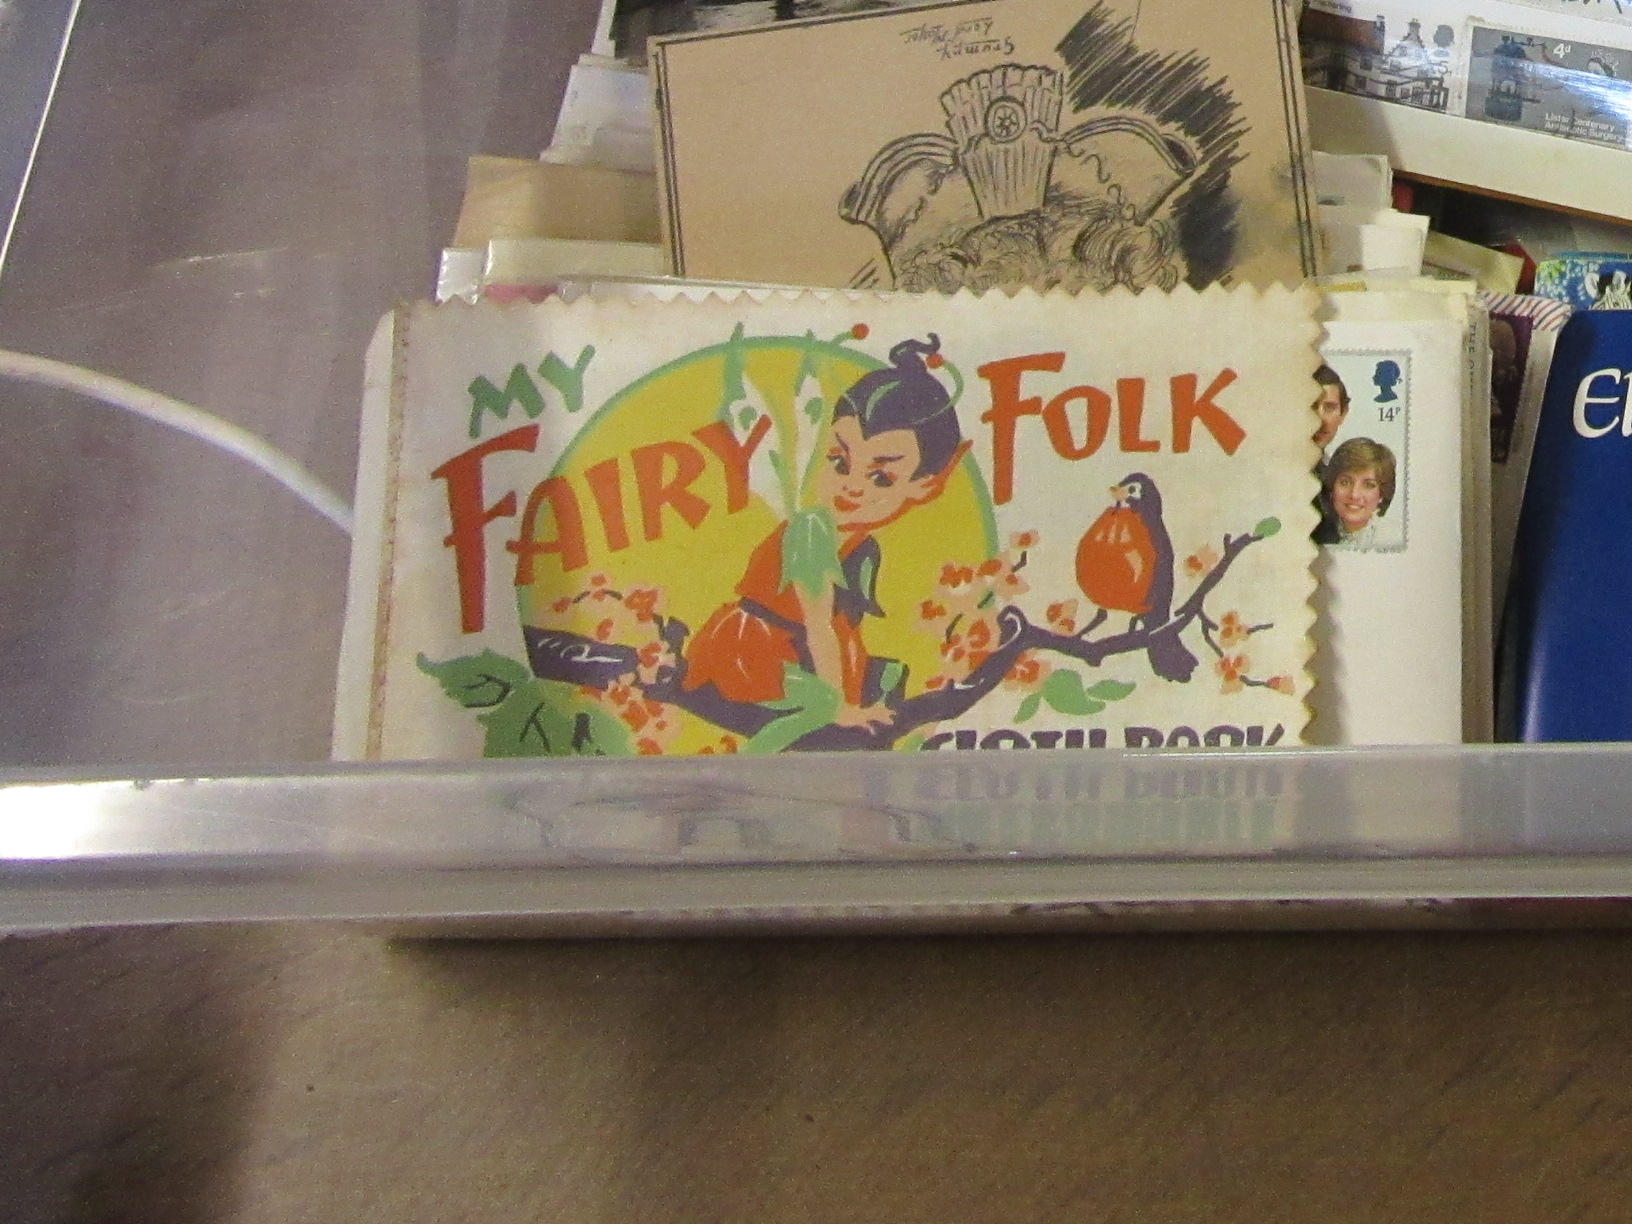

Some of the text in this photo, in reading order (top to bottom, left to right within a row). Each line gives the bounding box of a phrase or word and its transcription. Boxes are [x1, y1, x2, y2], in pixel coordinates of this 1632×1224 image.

[1552, 43, 1572, 60] 4d
[467, 344, 596, 440] MY
[976, 351, 1247, 505] FOLK
[430, 414, 773, 634] FAIRY
